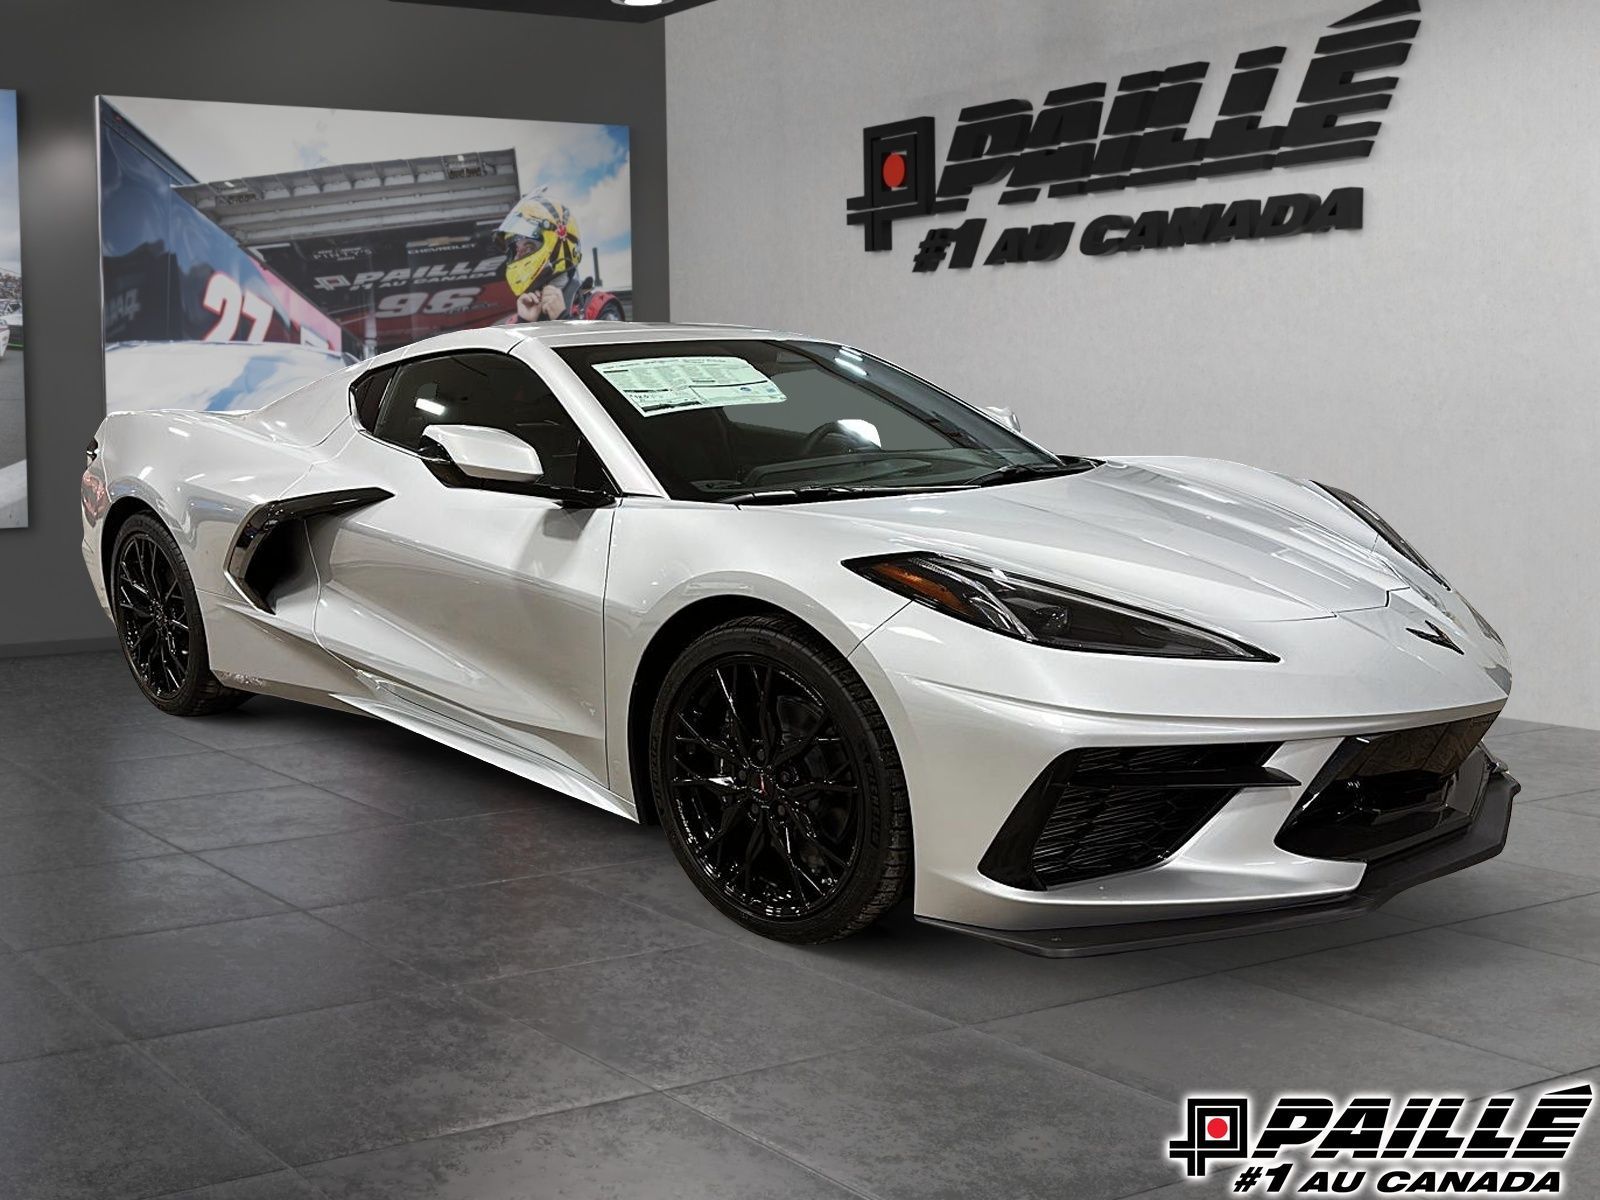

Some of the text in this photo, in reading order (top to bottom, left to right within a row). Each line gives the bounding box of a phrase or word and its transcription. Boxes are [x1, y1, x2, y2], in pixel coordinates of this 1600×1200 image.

[936, 0, 1421, 205] PAILLÉ
[912, 187, 1363, 273] #1 AU CANADA
[203, 272, 274, 342] 27
[376, 287, 481, 318] 96
